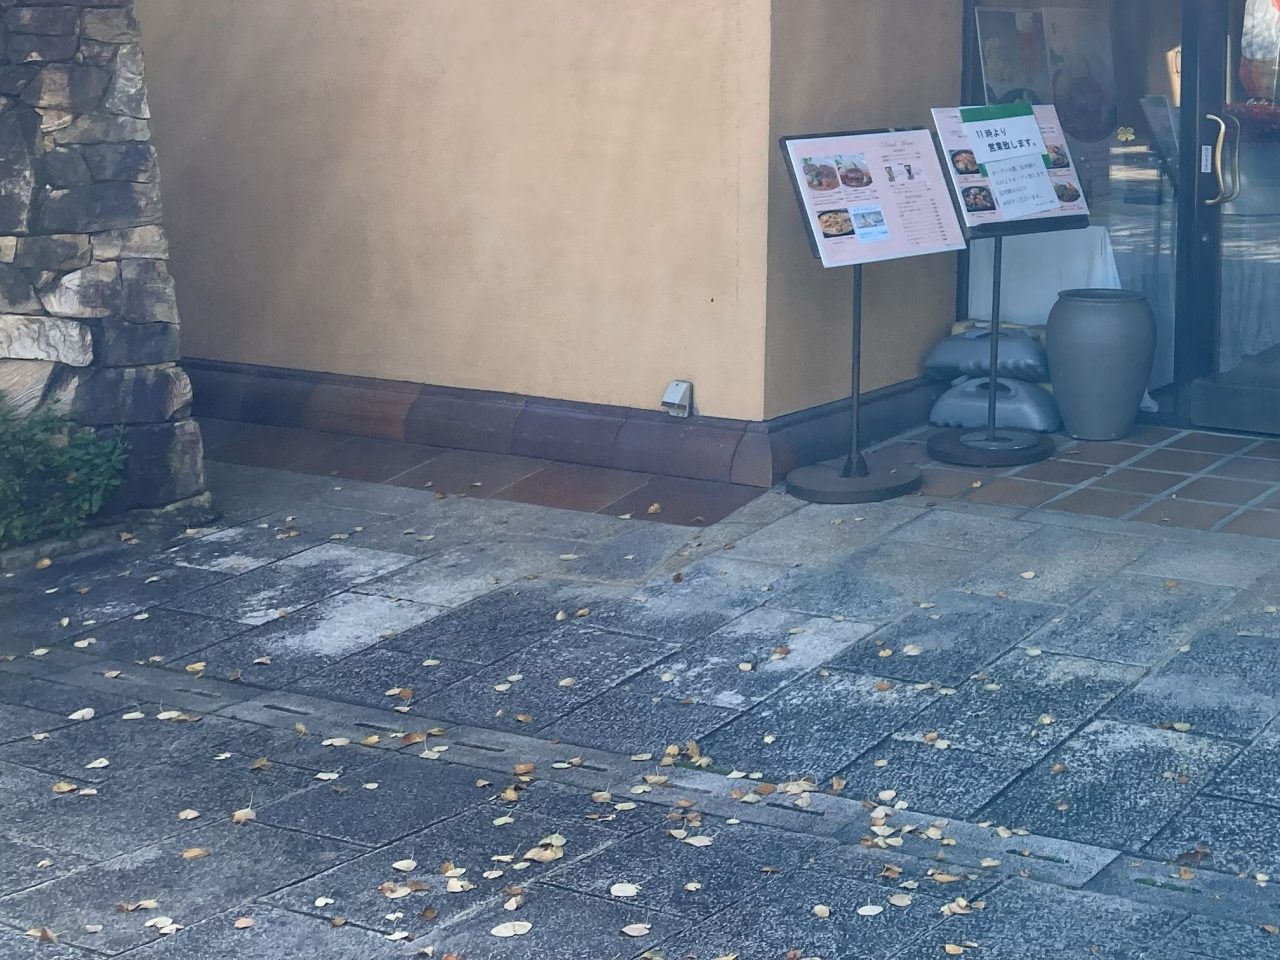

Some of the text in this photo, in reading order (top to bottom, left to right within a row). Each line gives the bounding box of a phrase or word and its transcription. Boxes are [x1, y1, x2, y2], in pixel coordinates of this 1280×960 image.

[975, 127, 1007, 139] 11時より
[987, 138, 1037, 153] 営業致します。
